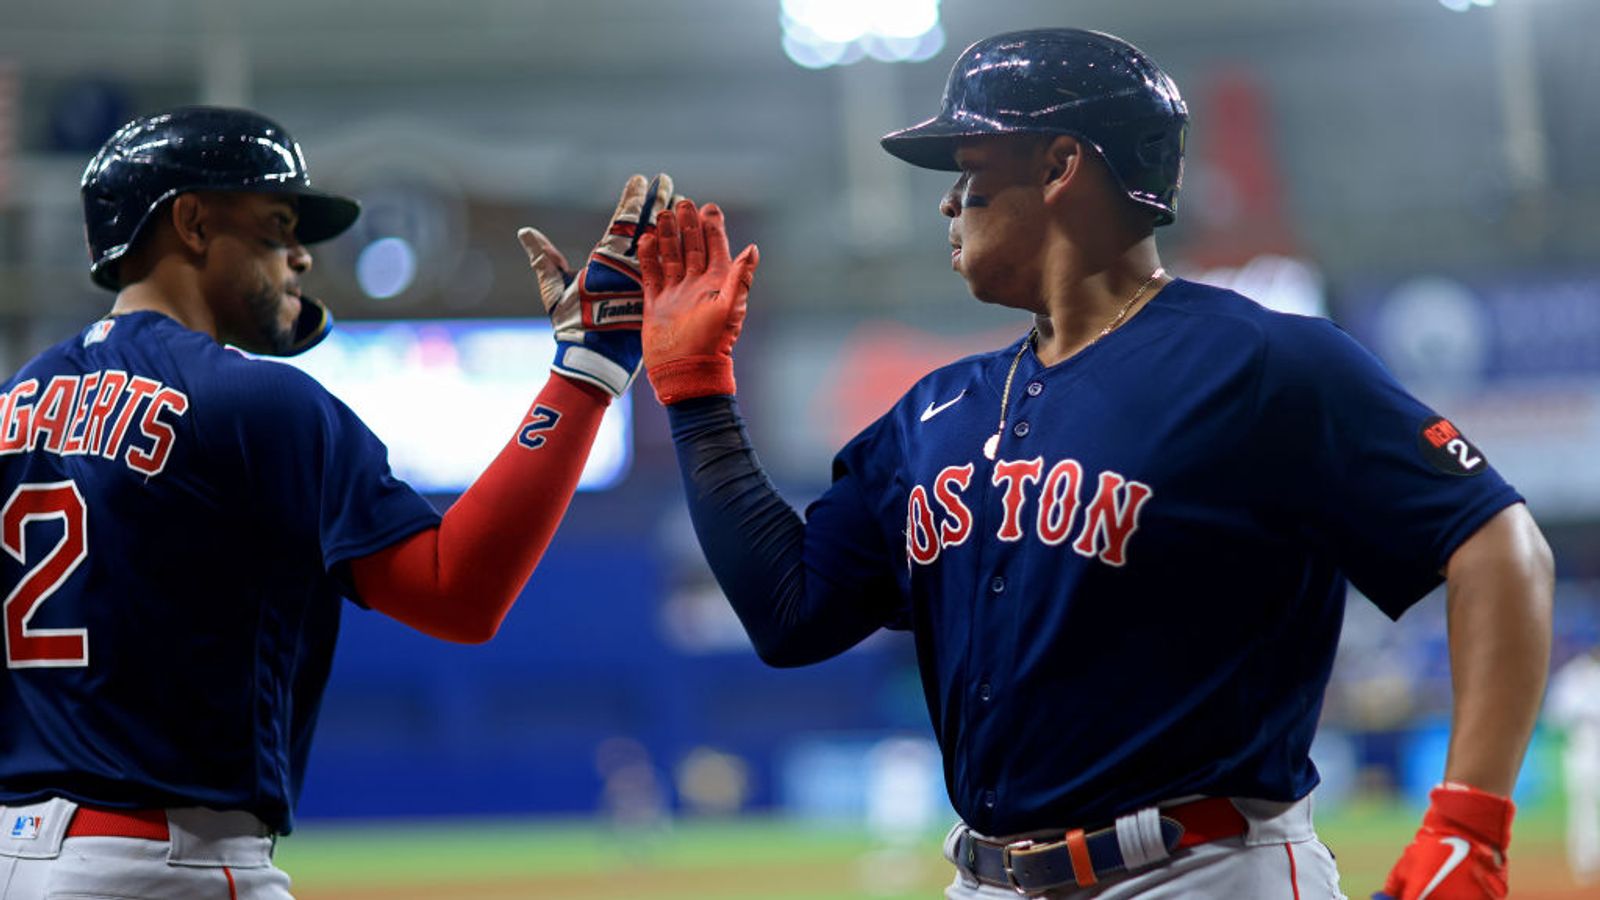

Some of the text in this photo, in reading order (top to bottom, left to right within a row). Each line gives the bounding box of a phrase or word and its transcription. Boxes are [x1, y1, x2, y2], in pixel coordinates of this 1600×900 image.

[597, 301, 643, 323] Frankli
[518, 404, 562, 450] 2
[1424, 419, 1460, 449] REM
[1447, 439, 1481, 469] 2
[907, 456, 1152, 567] OSTON
[1, 480, 88, 668] 2
